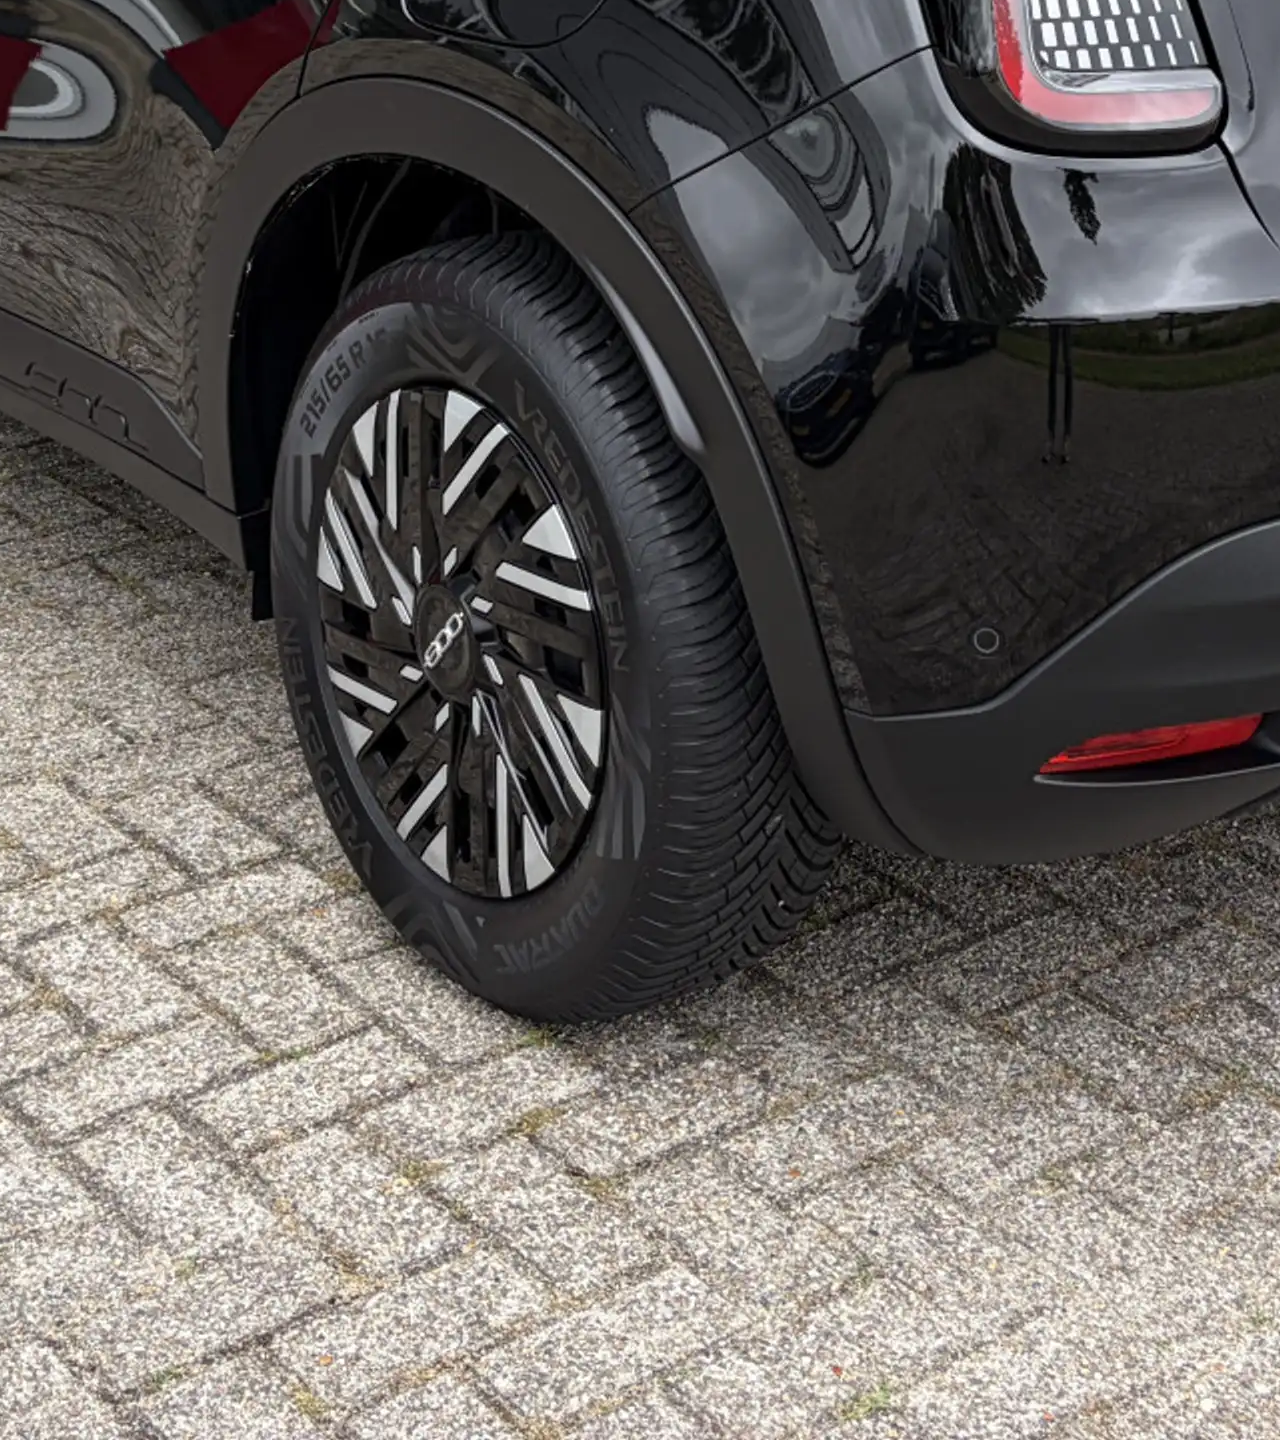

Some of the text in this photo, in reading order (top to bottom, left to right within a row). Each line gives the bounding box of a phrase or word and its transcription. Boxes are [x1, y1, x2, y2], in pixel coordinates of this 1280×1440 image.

[300, 353, 351, 439] 215/65
[513, 378, 631, 673] VREDESTEIN
[276, 615, 374, 880] VREDESTEIN
